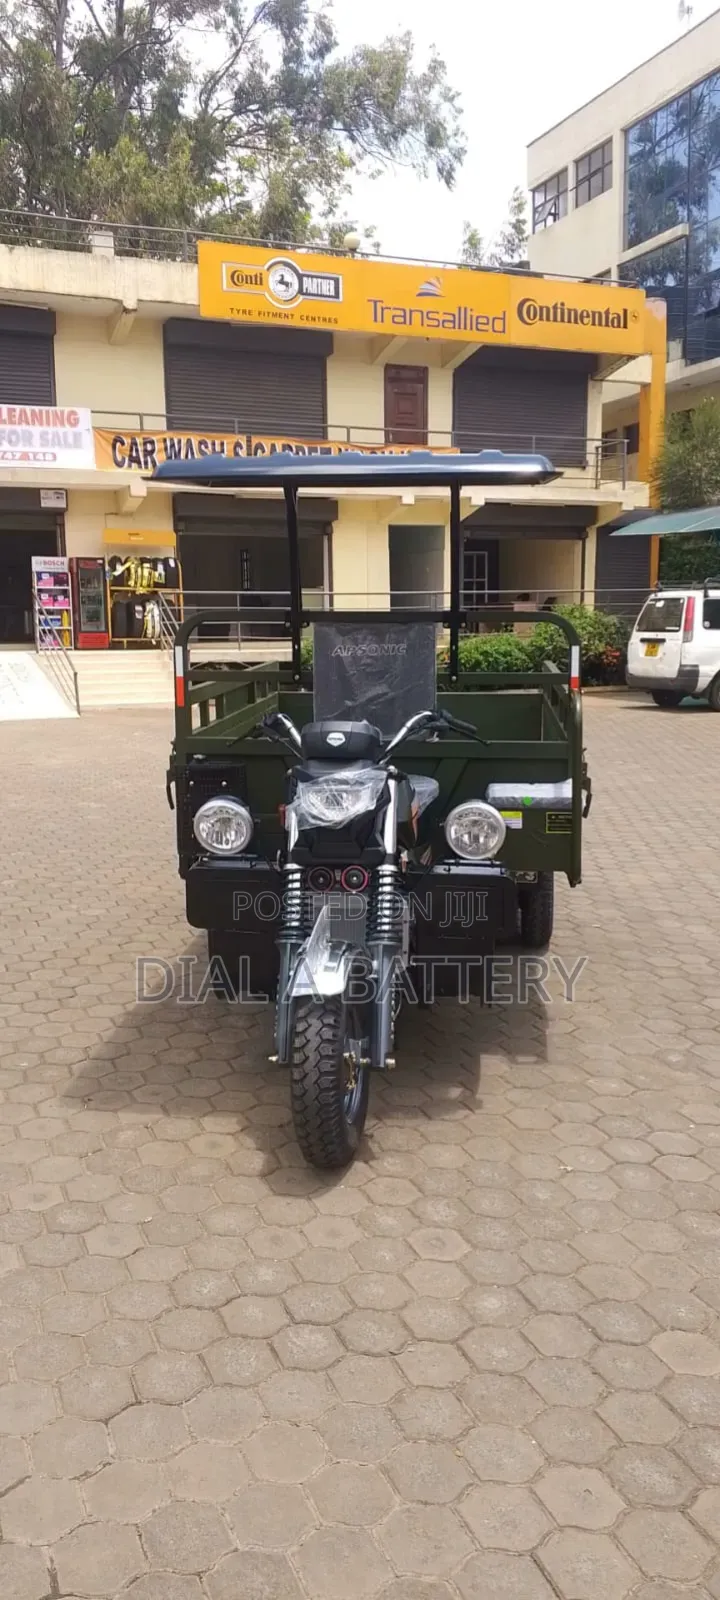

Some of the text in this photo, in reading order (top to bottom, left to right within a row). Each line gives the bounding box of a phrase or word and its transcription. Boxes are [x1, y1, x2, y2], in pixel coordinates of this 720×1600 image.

[230, 269, 263, 287] Conti
[302, 276, 335, 296] PARTNER
[229, 307, 338, 325] TYRE FITMENT CENTRES
[367, 299, 506, 334] Transallied
[516, 297, 628, 329] Continental
[39, 430, 83, 448] SALE
[111, 435, 157, 469] CAR
[331, 643, 407, 657] APSONIC
